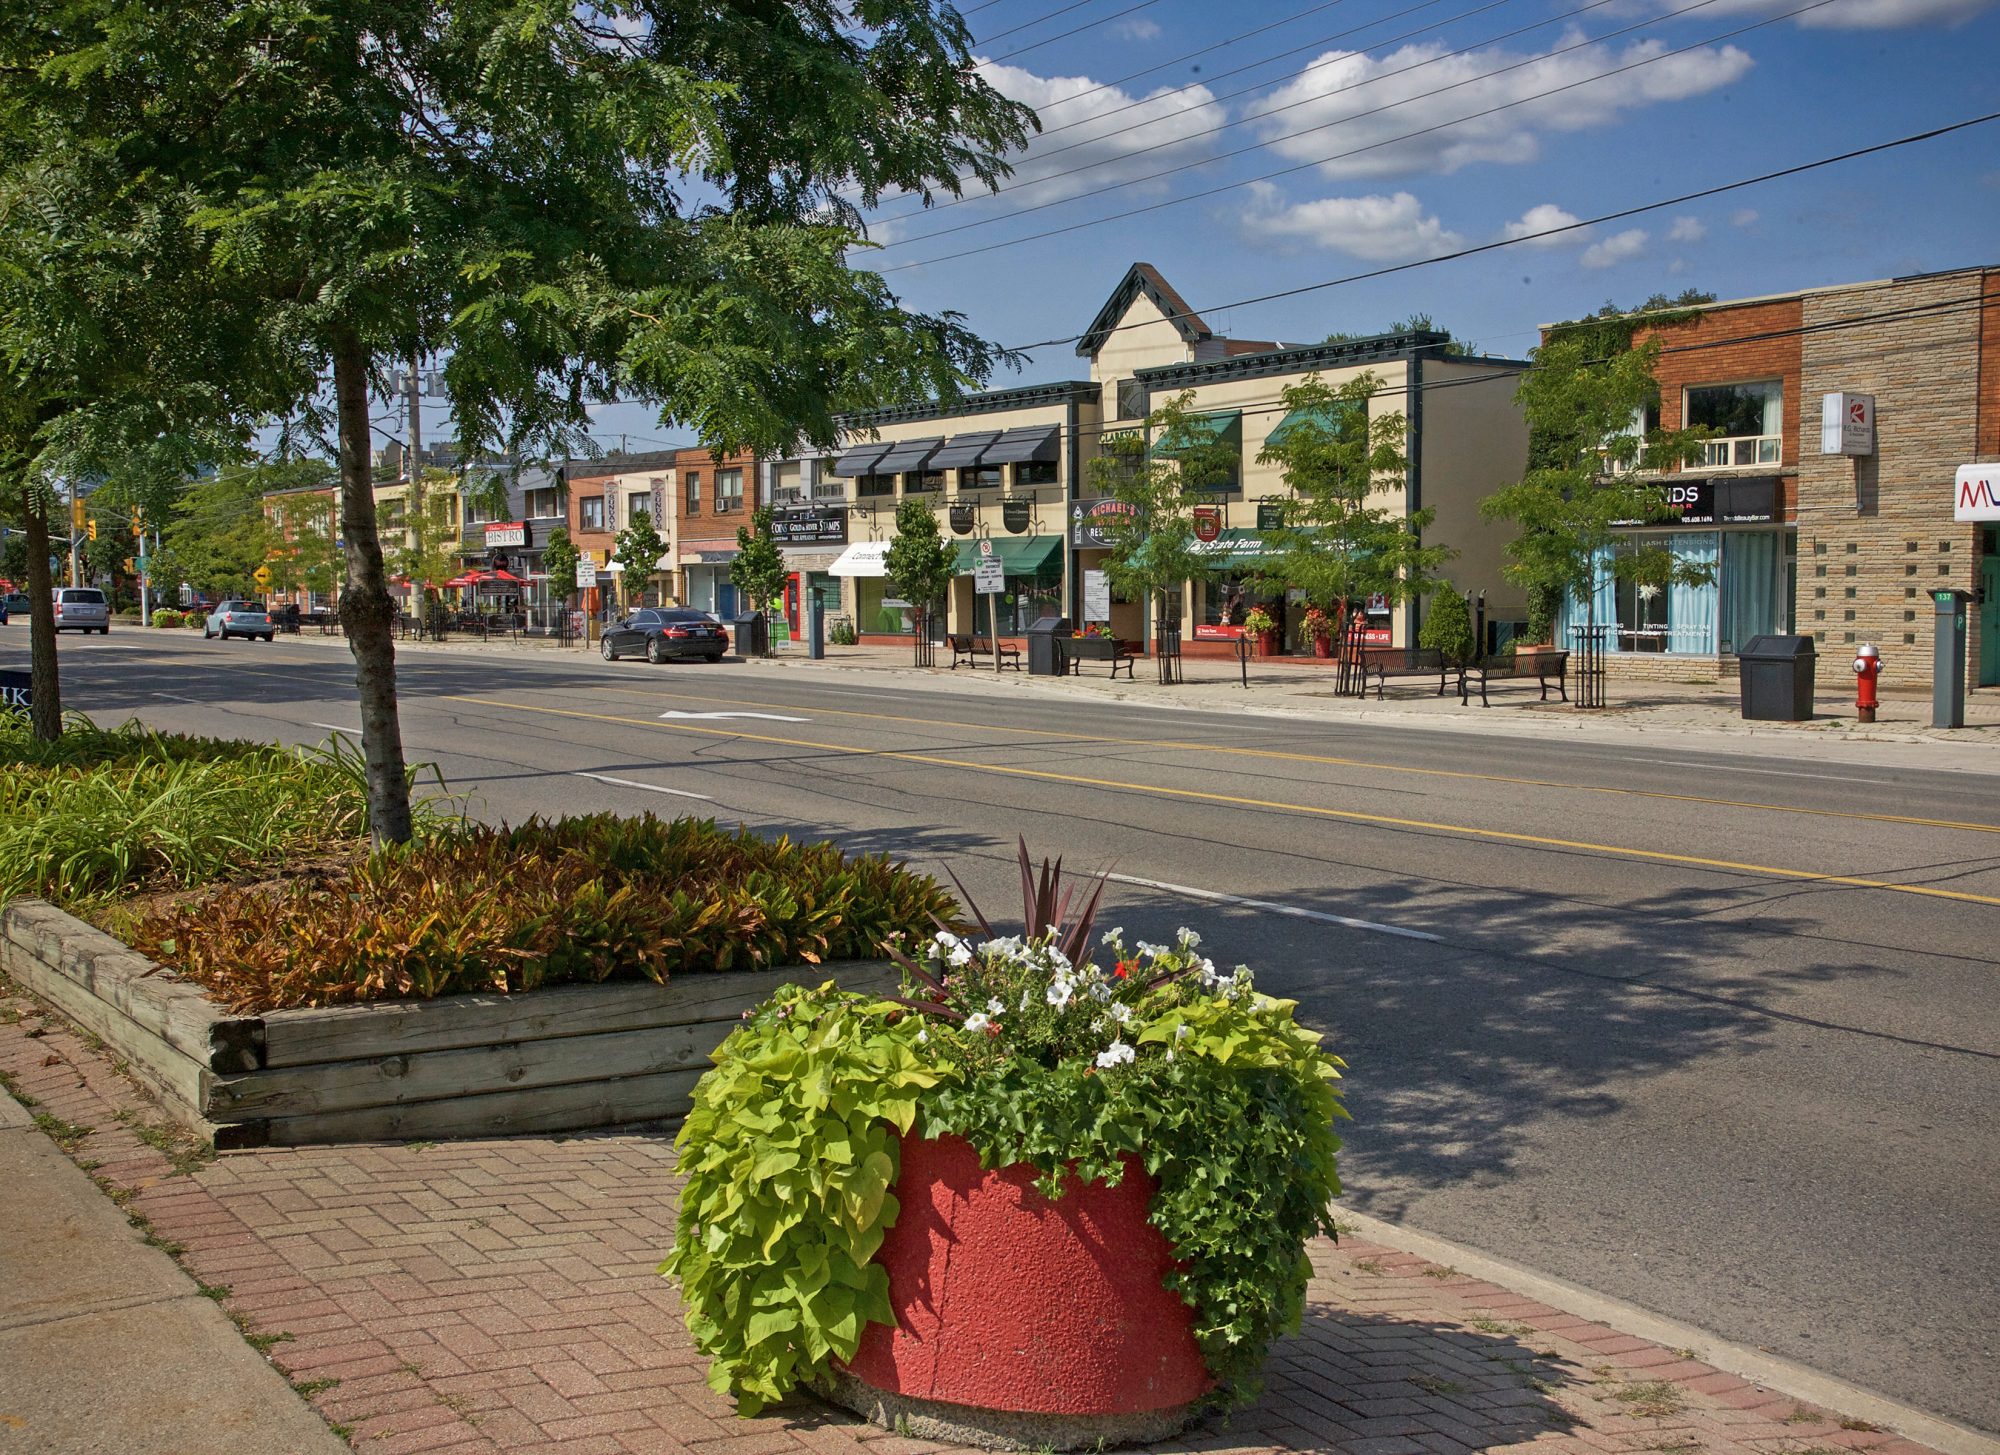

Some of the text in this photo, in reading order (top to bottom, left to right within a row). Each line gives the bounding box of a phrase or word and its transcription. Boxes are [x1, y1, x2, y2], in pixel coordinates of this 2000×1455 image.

[1091, 503, 1135, 516] MICHAEL'S
[488, 530, 523, 543] BISTRO
[1207, 539, 1262, 550] State Farm
